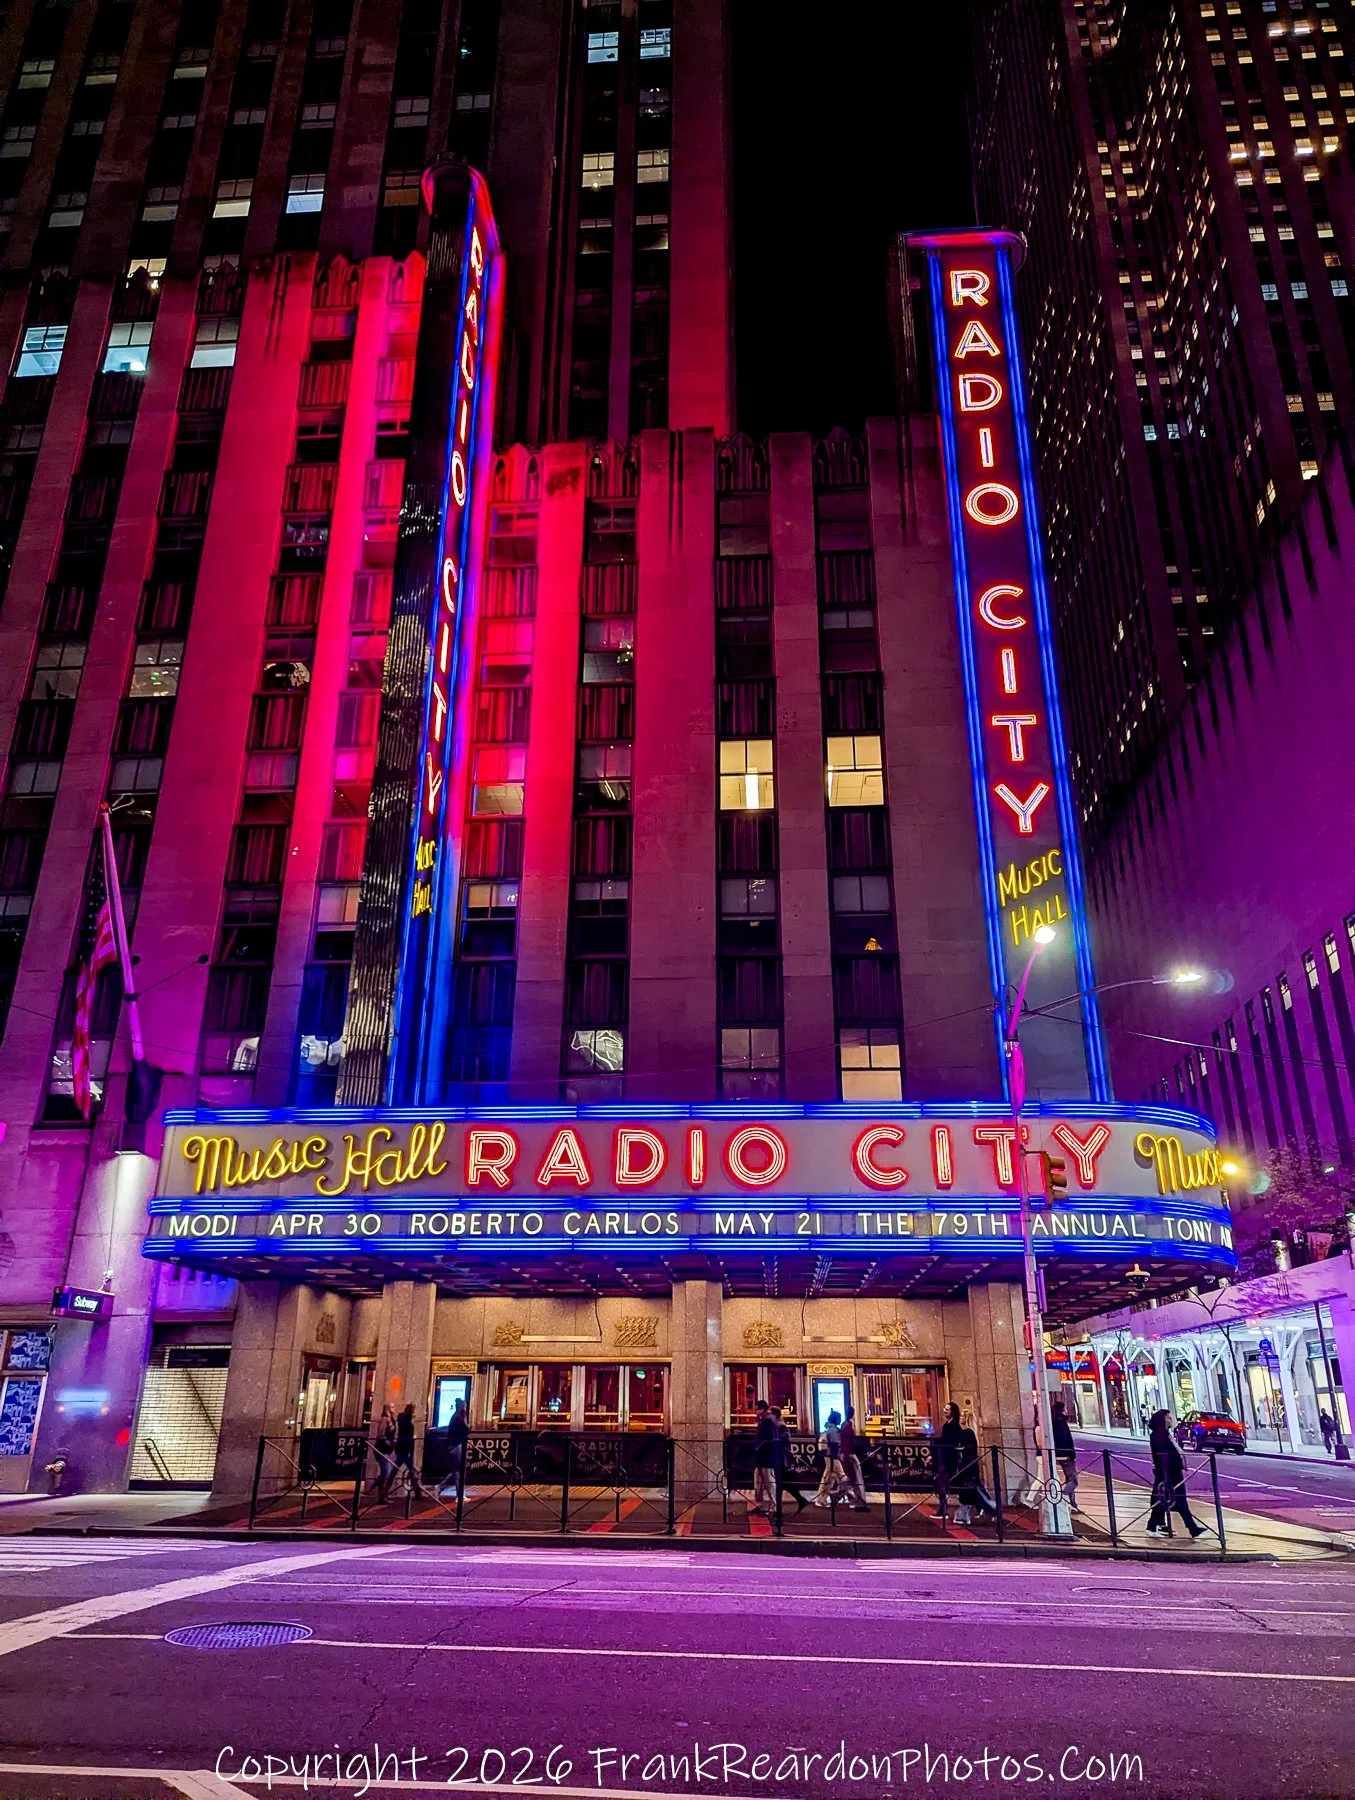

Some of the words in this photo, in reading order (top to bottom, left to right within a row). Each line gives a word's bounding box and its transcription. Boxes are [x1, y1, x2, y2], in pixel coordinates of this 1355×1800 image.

[451, 226, 483, 507] RADIO
[950, 270, 1019, 525] RADIO
[426, 557, 457, 815] CITY
[979, 584, 1049, 833] CITY
[997, 849, 1063, 907] MUSIC
[1011, 894, 1068, 946] HALL
[182, 1134, 327, 1194] Music
[315, 1121, 448, 1197] Hall
[467, 1127, 788, 1188] RADIO
[854, 1123, 1110, 1190] CITY
[169, 1214, 238, 1237] MODI
[270, 1213, 323, 1236] APR
[343, 1213, 382, 1235] 30
[411, 1212, 544, 1236] ROBERTO
[563, 1212, 679, 1236] CARLOS
[714, 1212, 775, 1235] MAY
[797, 1212, 822, 1235] 21
[857, 1212, 911, 1236] THE
[934, 1213, 1008, 1235] 79TH
[1031, 1214, 1145, 1238] ANNUAL
[1162, 1217, 1213, 1243] TONY
[74, 1295, 98, 1312] Subway
[465, 1449, 509, 1459] CITY
[466, 1439, 510, 1449] RADIO
[790, 1443, 816, 1454] DIO
[888, 1457, 931, 1468] ITY
